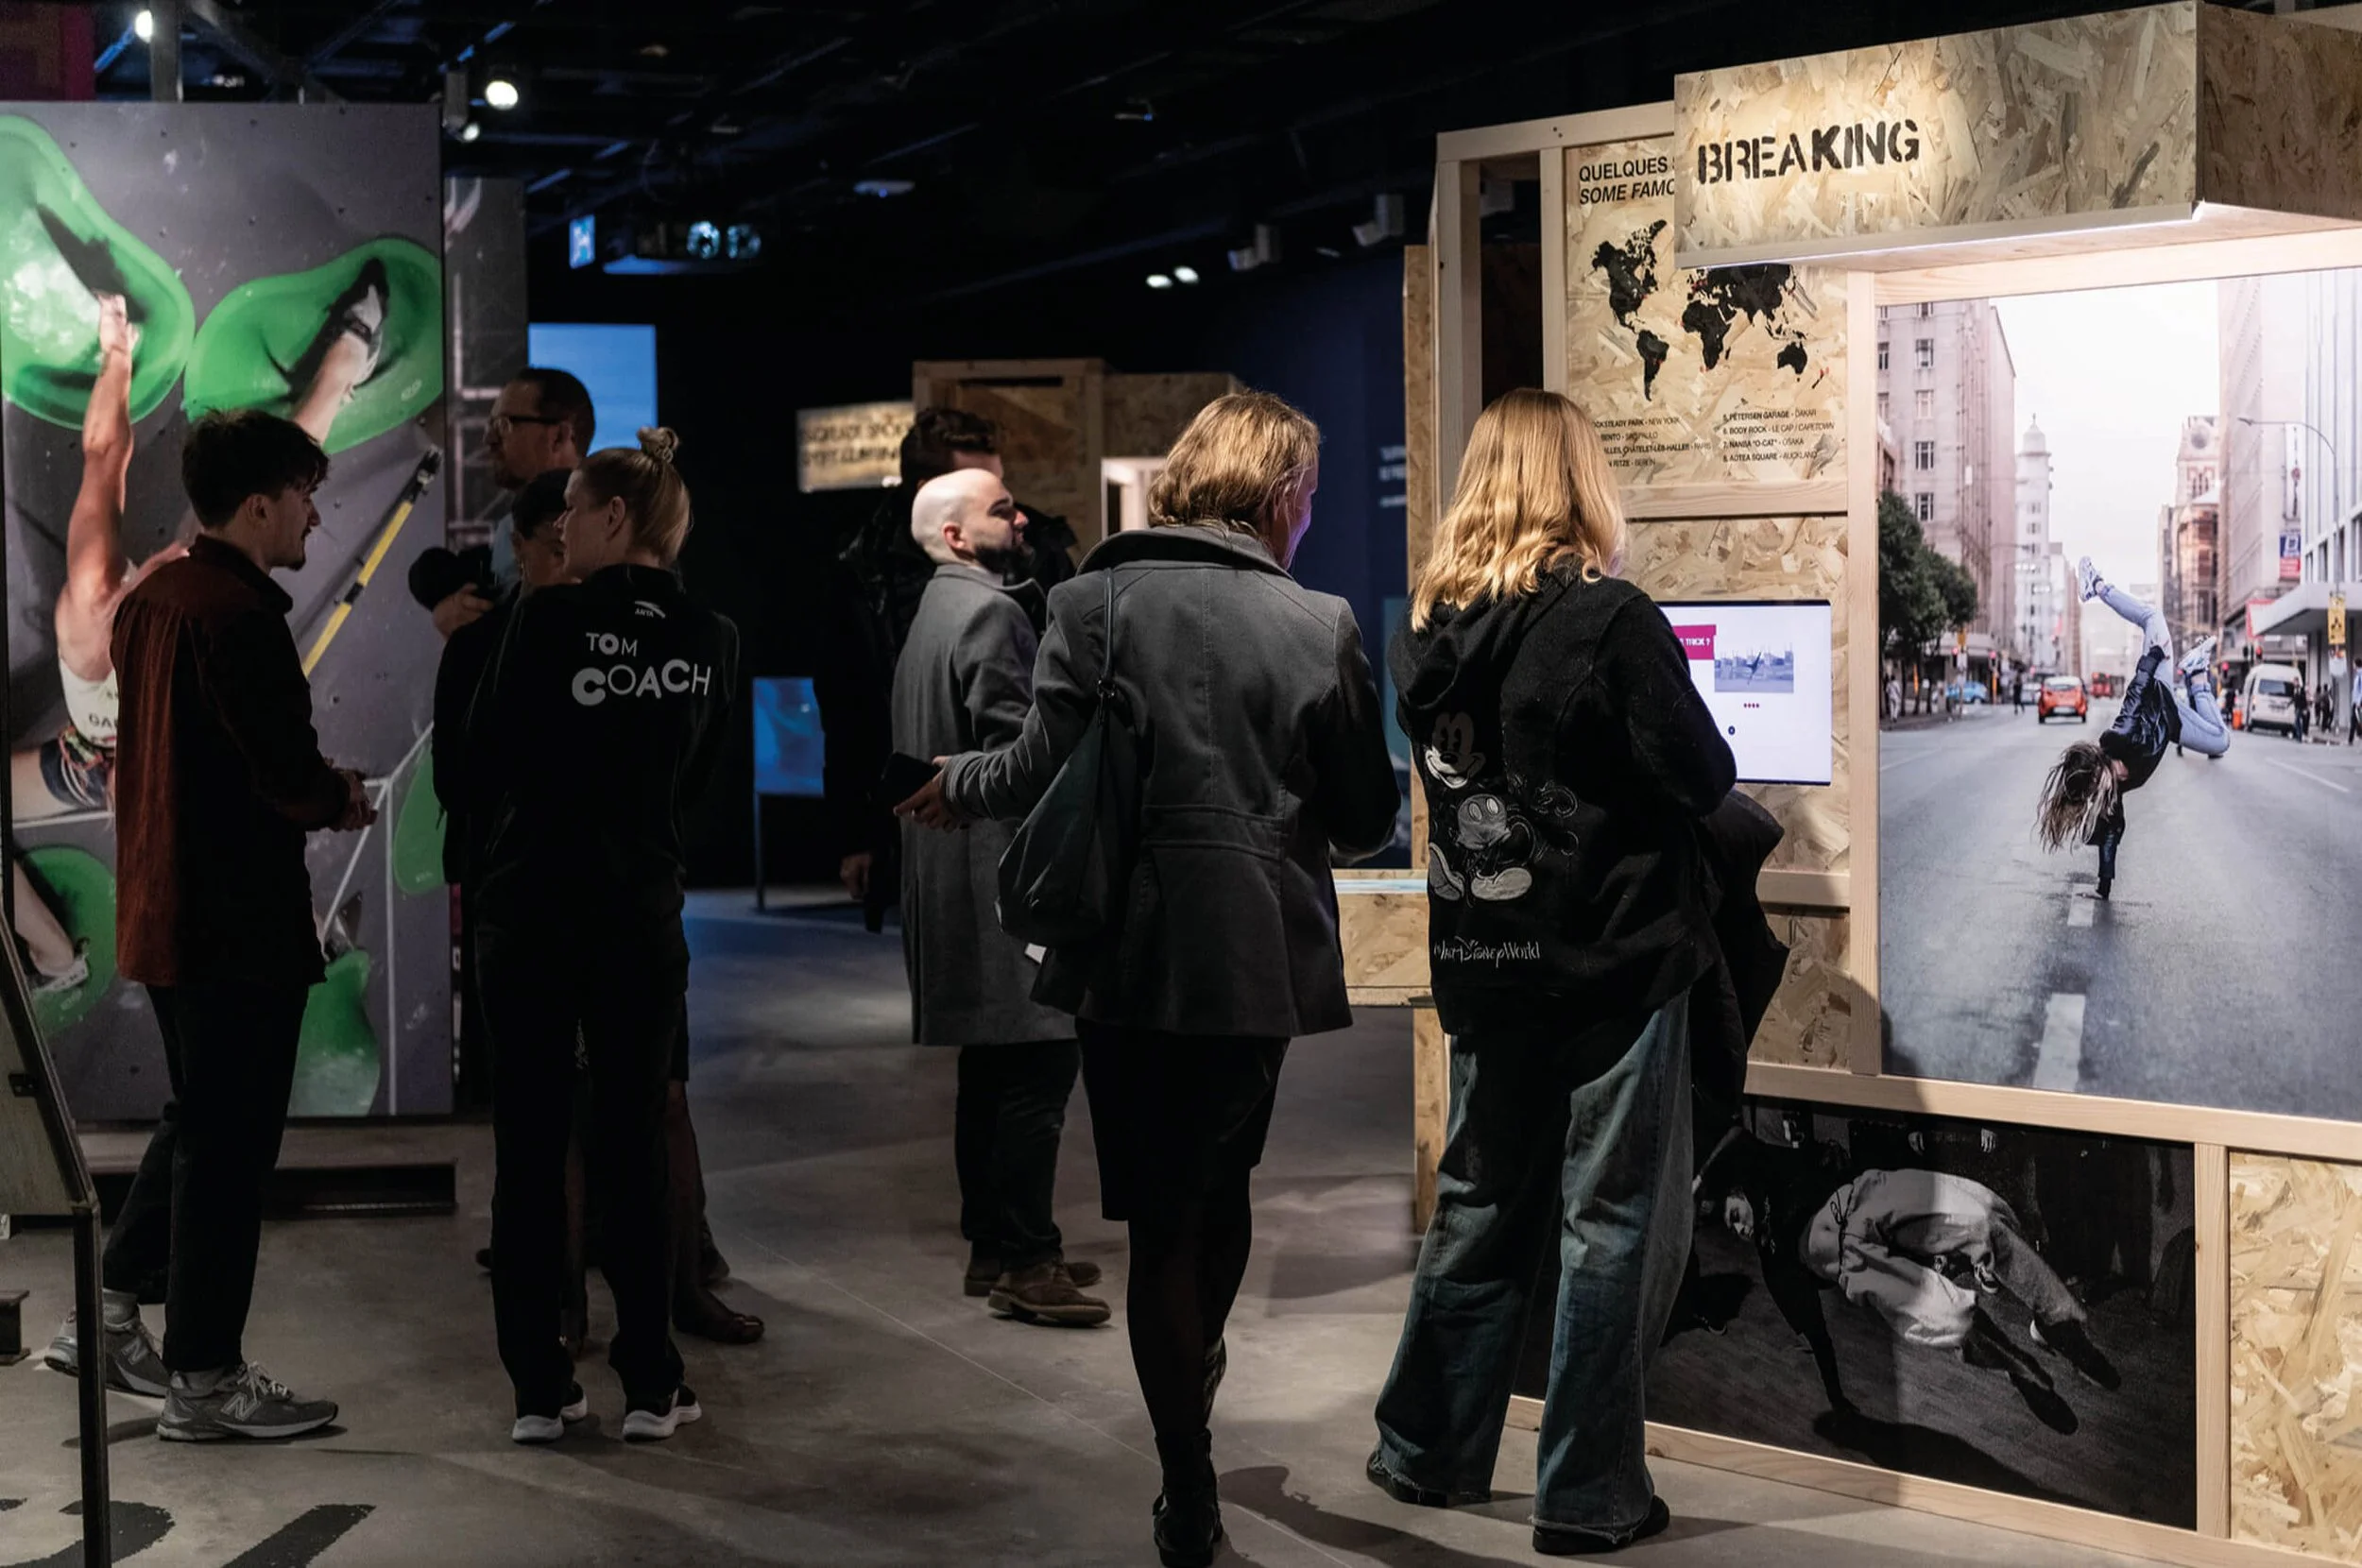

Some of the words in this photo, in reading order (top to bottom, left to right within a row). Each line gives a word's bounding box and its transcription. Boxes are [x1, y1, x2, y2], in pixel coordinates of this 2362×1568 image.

[1698, 119, 1919, 184] BREAKING
[1579, 156, 1668, 182] QUELQUES
[1580, 184, 1627, 205] SOME
[586, 632, 638, 657] TOM
[572, 658, 711, 707] COACH
